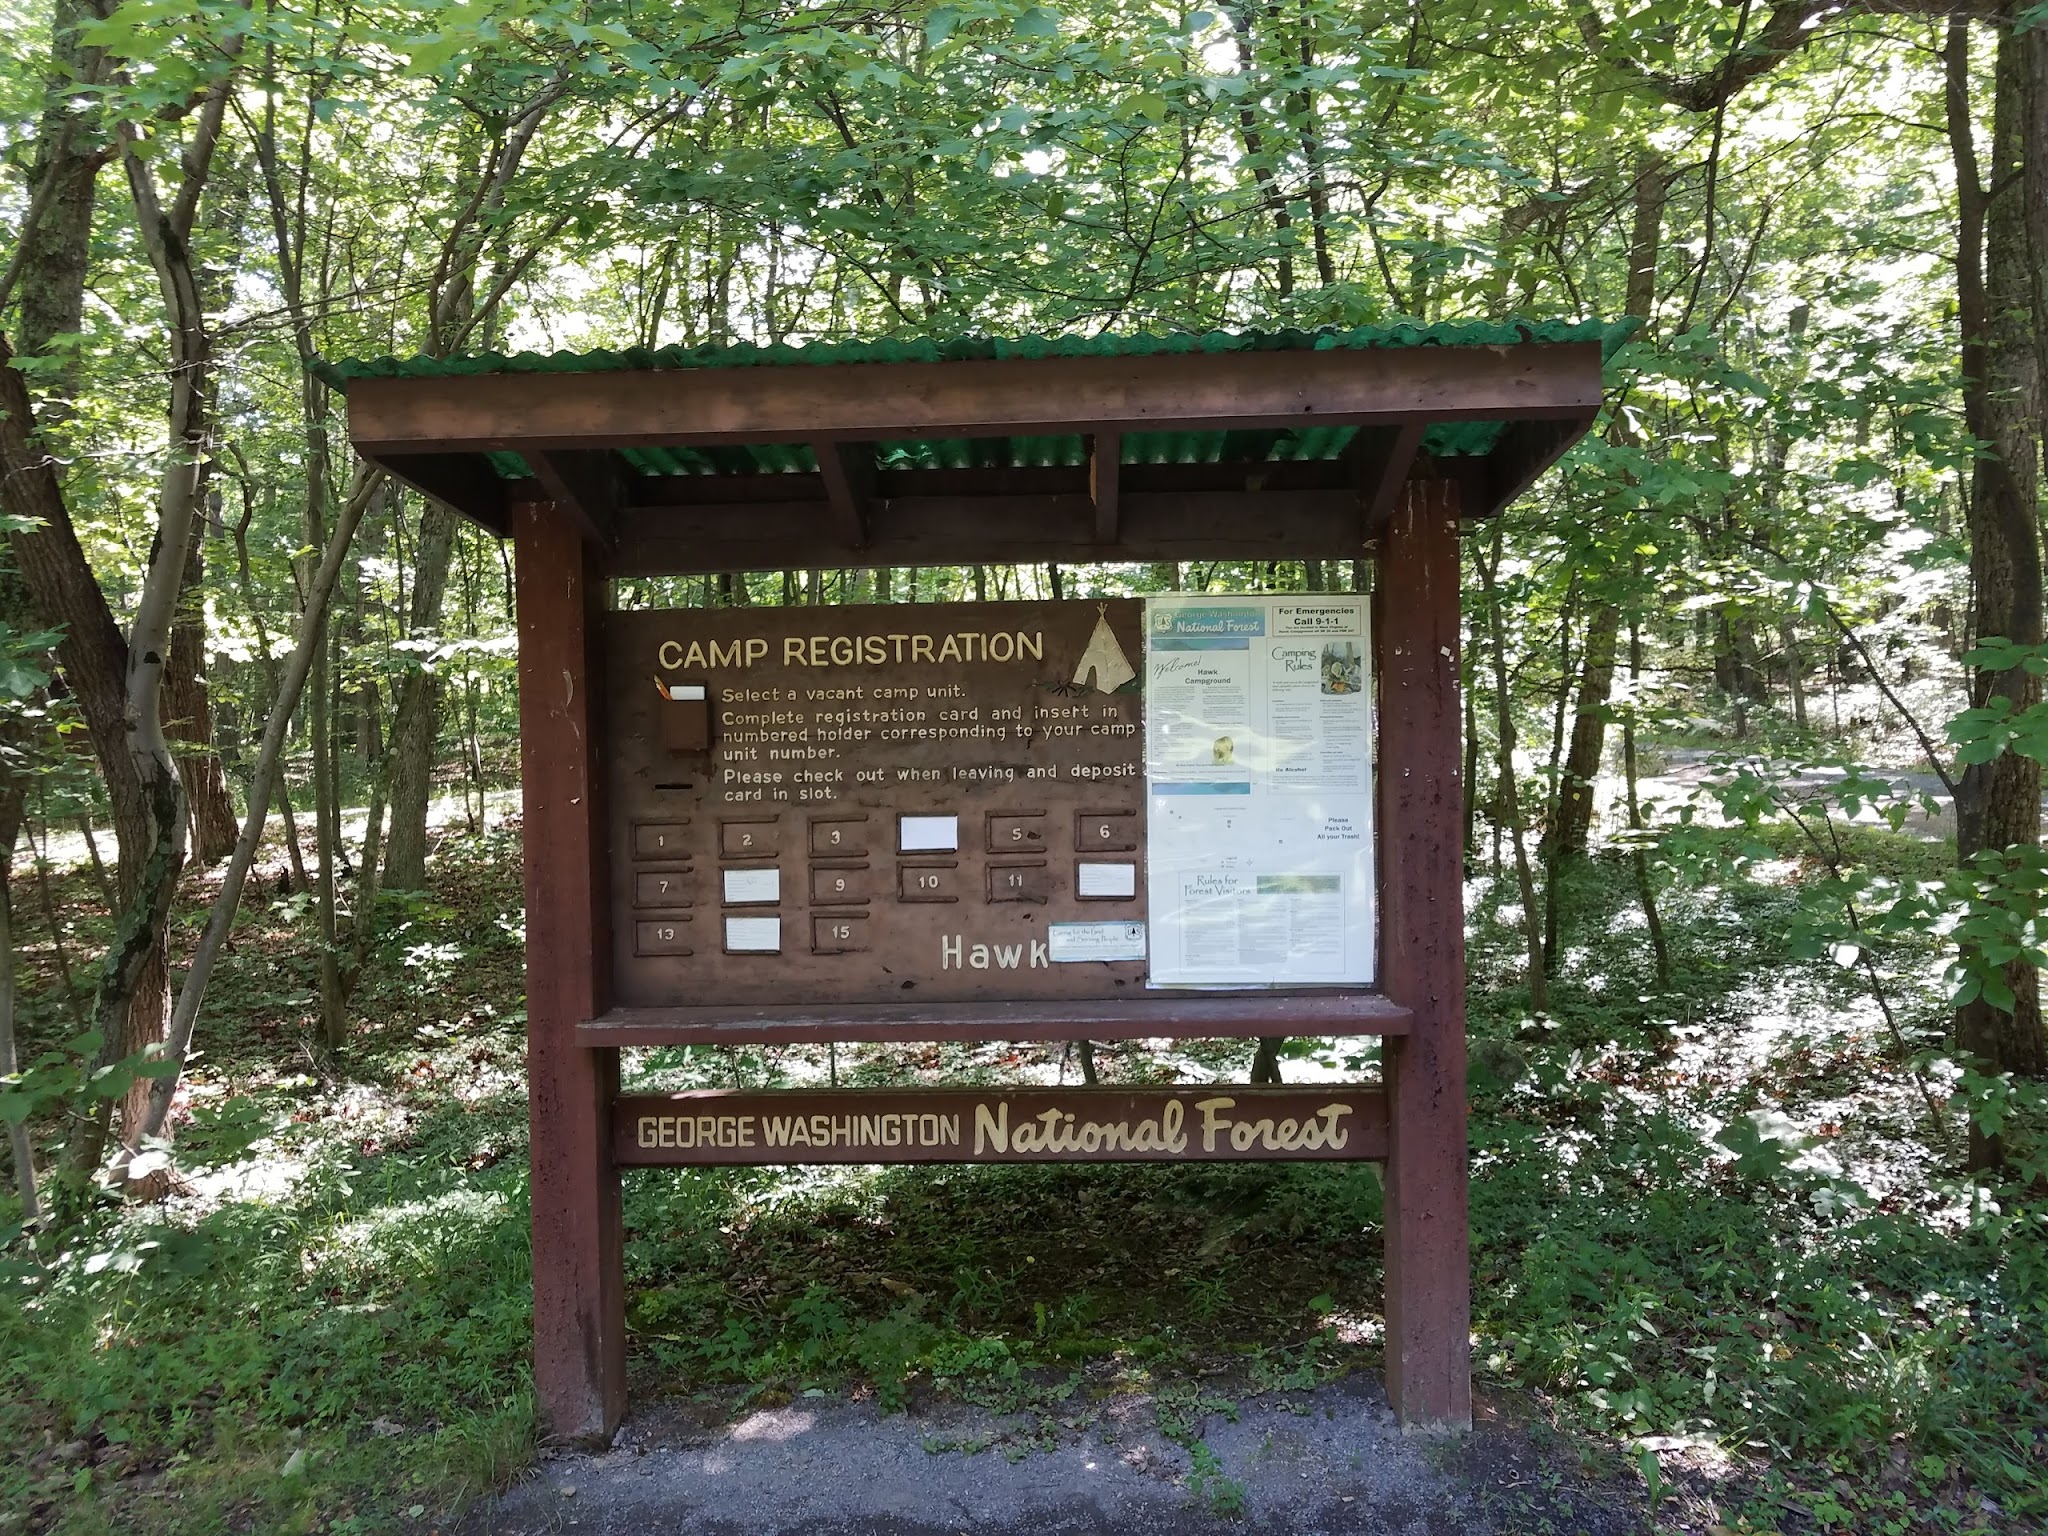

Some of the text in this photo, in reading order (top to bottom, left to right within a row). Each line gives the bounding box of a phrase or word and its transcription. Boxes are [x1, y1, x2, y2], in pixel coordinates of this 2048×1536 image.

[1296, 607, 1355, 616] Emergencies
[1176, 619, 1260, 633] National Forest
[1294, 617, 1339, 625] Call 9-1-1
[658, 631, 1043, 670] CAMP REGISTRATION
[1271, 646, 1317, 661] Camping
[1153, 655, 1202, 680] Welcome!
[1285, 659, 1313, 672] Rules
[1184, 677, 1231, 685] Campground
[721, 684, 966, 703] Select a vacant camp unit.
[721, 704, 1118, 727] Complete registration card and insert in
[722, 723, 1136, 743] numbered holder corresponding to your camp
[723, 745, 841, 761] unit number.
[723, 762, 1136, 785] Please check out when leaving and deposit
[724, 786, 838, 802] card in slot.
[831, 830, 841, 844] 3
[1012, 828, 1022, 841] 5
[1100, 824, 1111, 839] 6
[658, 835, 665, 847] 1
[742, 834, 753, 846] 2
[659, 881, 669, 893] 7
[835, 878, 845, 892] 9
[919, 875, 939, 888] 10
[1008, 874, 1023, 887] 11
[1196, 874, 1239, 886] Rules for
[1184, 884, 1213, 897] Forest
[657, 928, 674, 940] 13
[832, 925, 850, 939] 15
[942, 934, 1048, 970] Hawk
[637, 1096, 1354, 1156] GEORGE WASHINGTON National Forest
